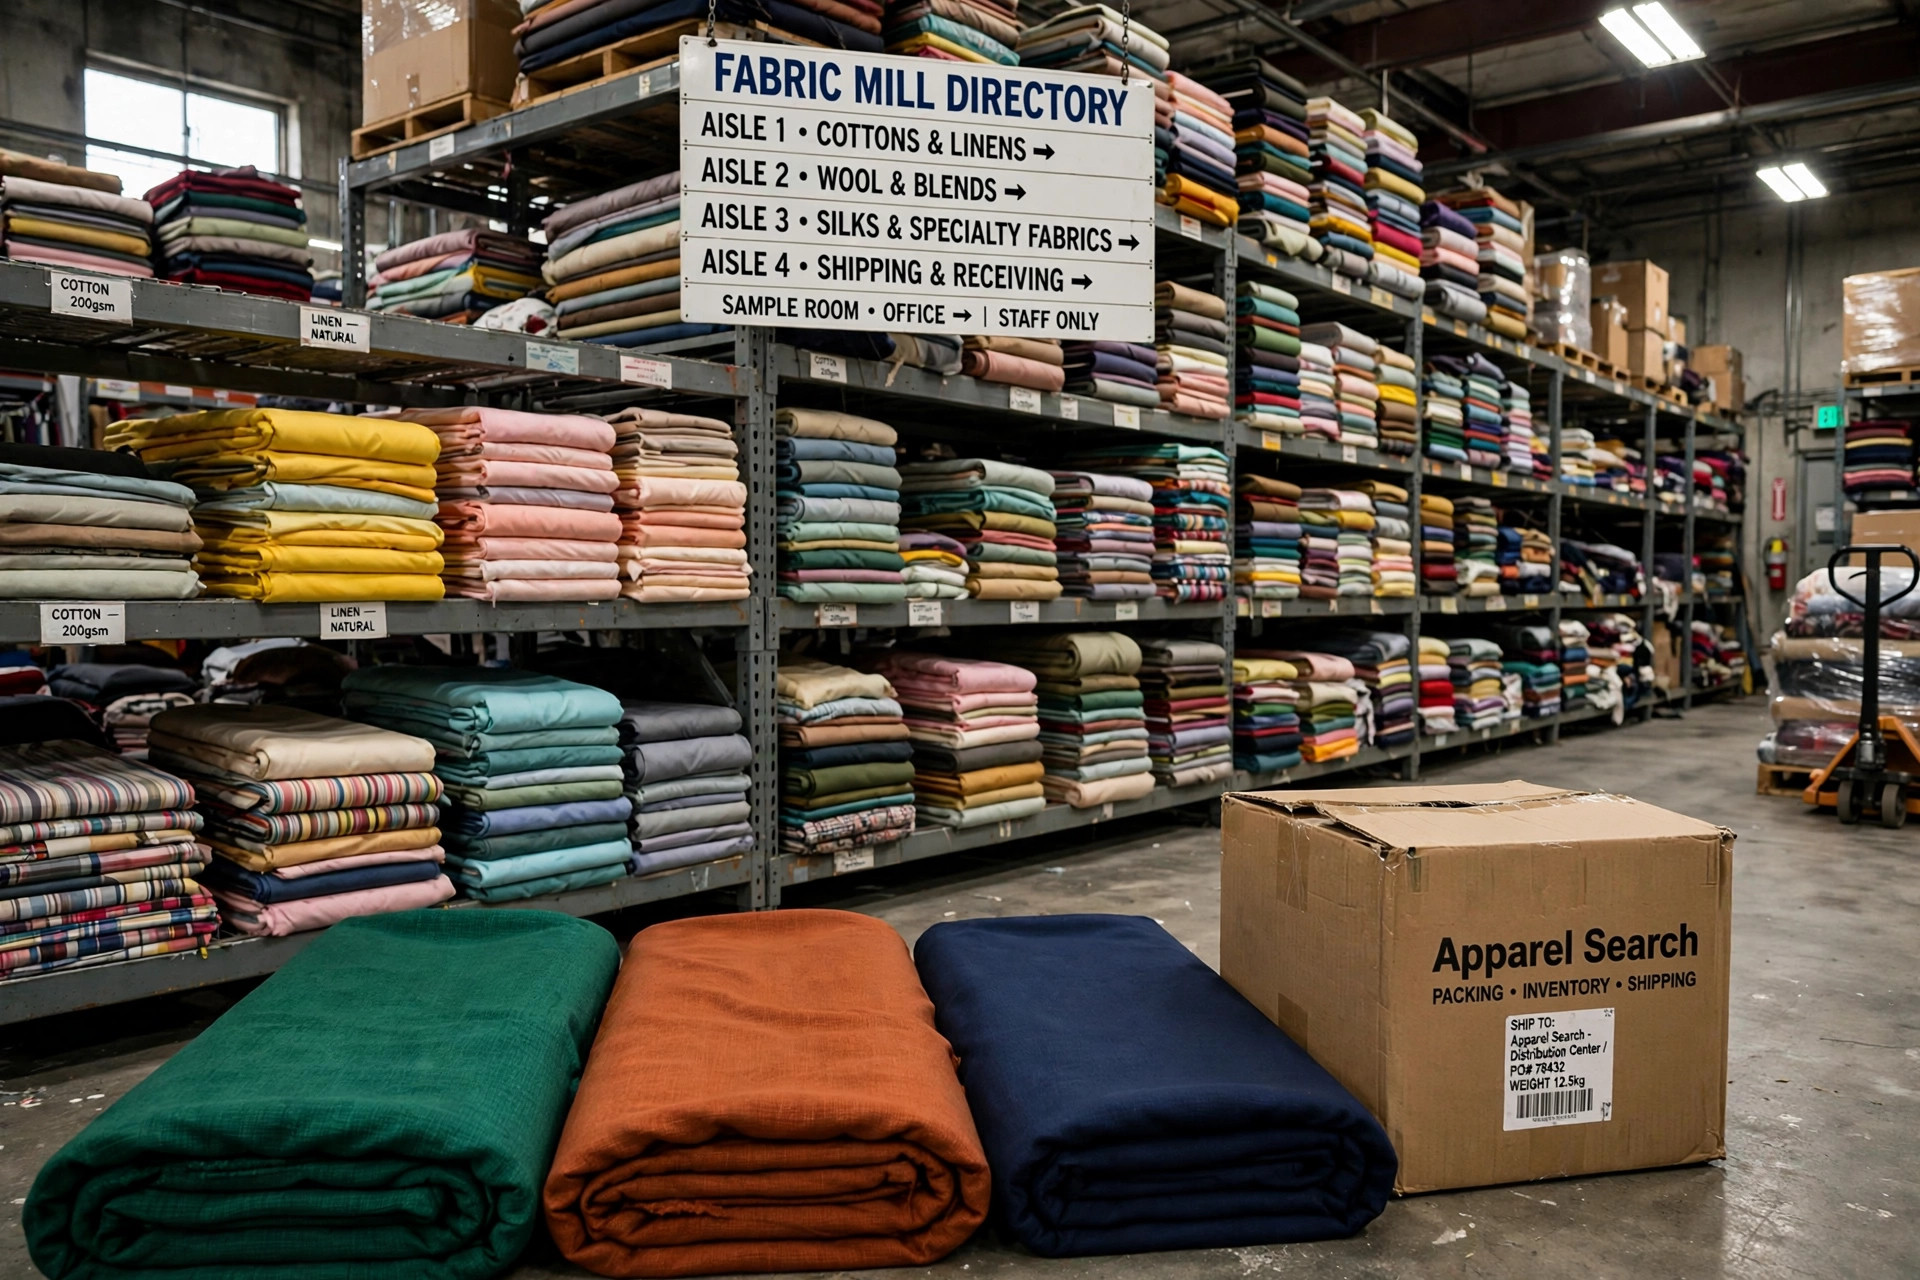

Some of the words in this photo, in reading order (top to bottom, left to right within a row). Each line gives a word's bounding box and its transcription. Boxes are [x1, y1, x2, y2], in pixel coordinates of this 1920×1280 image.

[716, 52, 841, 101] FABRIC
[855, 66, 934, 109] MILL
[948, 74, 1128, 126] DIRECTORY
[701, 112, 766, 140] AISLE
[777, 118, 784, 142] 1
[817, 121, 919, 152] COTTONS
[928, 130, 943, 154] &
[951, 132, 1026, 161] LINENS
[702, 157, 766, 185] AISLE
[776, 162, 788, 187] 2
[818, 165, 883, 194] WOOL
[891, 171, 905, 195] &
[915, 173, 996, 202] BLENDS
[701, 203, 766, 231] AISLE
[776, 207, 788, 232] 3
[817, 210, 879, 238] SILKS
[887, 215, 902, 239] &
[910, 216, 1021, 246] SPECIALTY
[1029, 224, 1112, 252] FABRICS
[702, 249, 767, 276] AISLE
[775, 253, 789, 277] 4
[818, 255, 921, 284] SHIPPING
[931, 261, 945, 285] &
[954, 263, 1063, 292] RECEIVING
[61, 278, 109, 295] COTTON
[71, 296, 114, 312] 200gsm
[723, 295, 798, 317] SAMPLE
[805, 299, 858, 320] ROOM
[884, 302, 945, 324] OFFICE
[999, 308, 1050, 328] STAFF
[1057, 311, 1099, 330] ONLY
[312, 314, 341, 327] LINEN
[312, 329, 356, 343] NATURAL
[52, 609, 100, 620] COTTON
[331, 607, 360, 617] LINEN
[63, 625, 108, 639] 200gsm
[331, 621, 374, 632] NATURAL
[1432, 930, 1572, 980] Apparel
[1584, 923, 1697, 963] Search
[1433, 985, 1503, 1004] PACKING
[1524, 977, 1610, 999] INVENTORY
[1628, 971, 1696, 991] SHIPPING
[1511, 1018, 1534, 1030] SHIP
[1538, 1017, 1554, 1028] TO:
[1511, 1032, 1548, 1048] Apparel
[1552, 1029, 1584, 1042] Search
[1511, 1046, 1566, 1061] Distribution
[1570, 1044, 1600, 1055] Center
[1511, 1064, 1532, 1076] PO#
[1510, 1077, 1550, 1091] WEIGHT
[1555, 1076, 1585, 1088] 12.5kg
